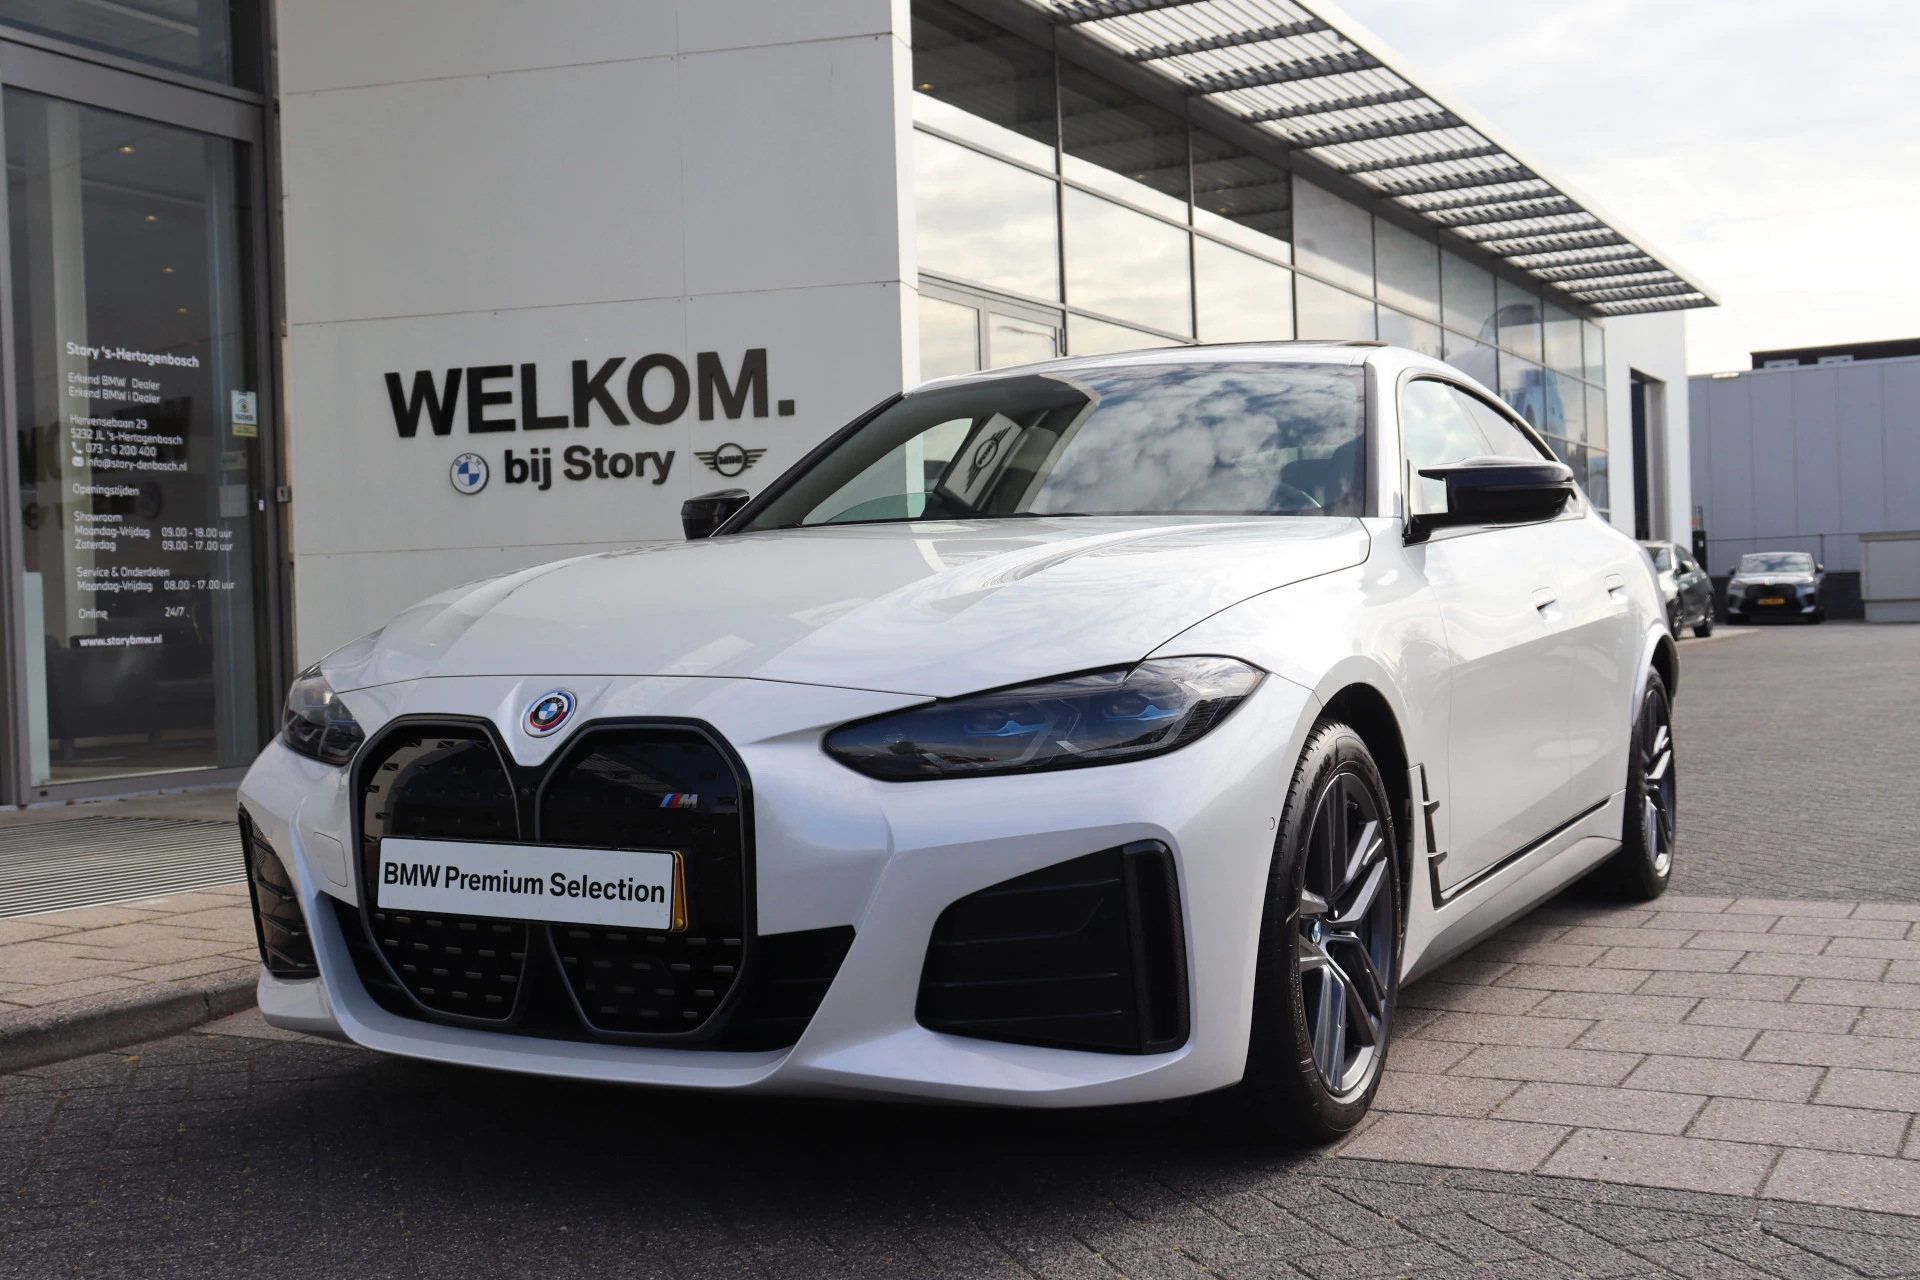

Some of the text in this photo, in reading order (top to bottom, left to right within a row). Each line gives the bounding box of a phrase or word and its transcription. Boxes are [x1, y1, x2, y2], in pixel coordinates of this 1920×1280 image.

[66, 342, 200, 368] Story 's-Hertogenbosch
[68, 372, 160, 391] Erkend BMW Dealer
[69, 386, 101, 399] Erkend
[102, 389, 127, 401] BMW
[133, 391, 161, 404] Dealer
[384, 347, 795, 438] WELKOM.
[70, 414, 148, 429] Hervensebaan 29
[71, 428, 183, 445] 5232 JL 's-Hertogenbosch
[85, 443, 103, 454] 073
[110, 445, 118, 455] 6
[119, 445, 137, 456] 200
[138, 446, 157, 457] 400
[86, 457, 188, 472] info@story-denbosch.nl
[454, 454, 482, 467] BMW
[718, 454, 743, 465] MINI
[504, 444, 676, 491] bij Story
[72, 483, 140, 497] Openingstijden
[74, 511, 123, 522] Showroom
[74, 525, 150, 539] Maandag-Vrijdag
[161, 527, 187, 537] 09.00
[194, 527, 217, 538] 18.00
[218, 530, 233, 538] uur
[75, 539, 116, 552] Zaterdag
[162, 540, 188, 551] 09.00
[195, 540, 218, 551] 17.00
[219, 543, 234, 551] uur
[76, 566, 170, 578] Service & Onderdelen
[77, 580, 153, 593] Maandag-Vrijdag
[163, 580, 190, 590] 08.00
[197, 580, 220, 590] 17.00
[221, 581, 235, 590] uur
[78, 606, 186, 619] Online 24/7
[79, 634, 163, 646] www.storybmw.nl
[383, 861, 665, 903] BMW Premium Selection
